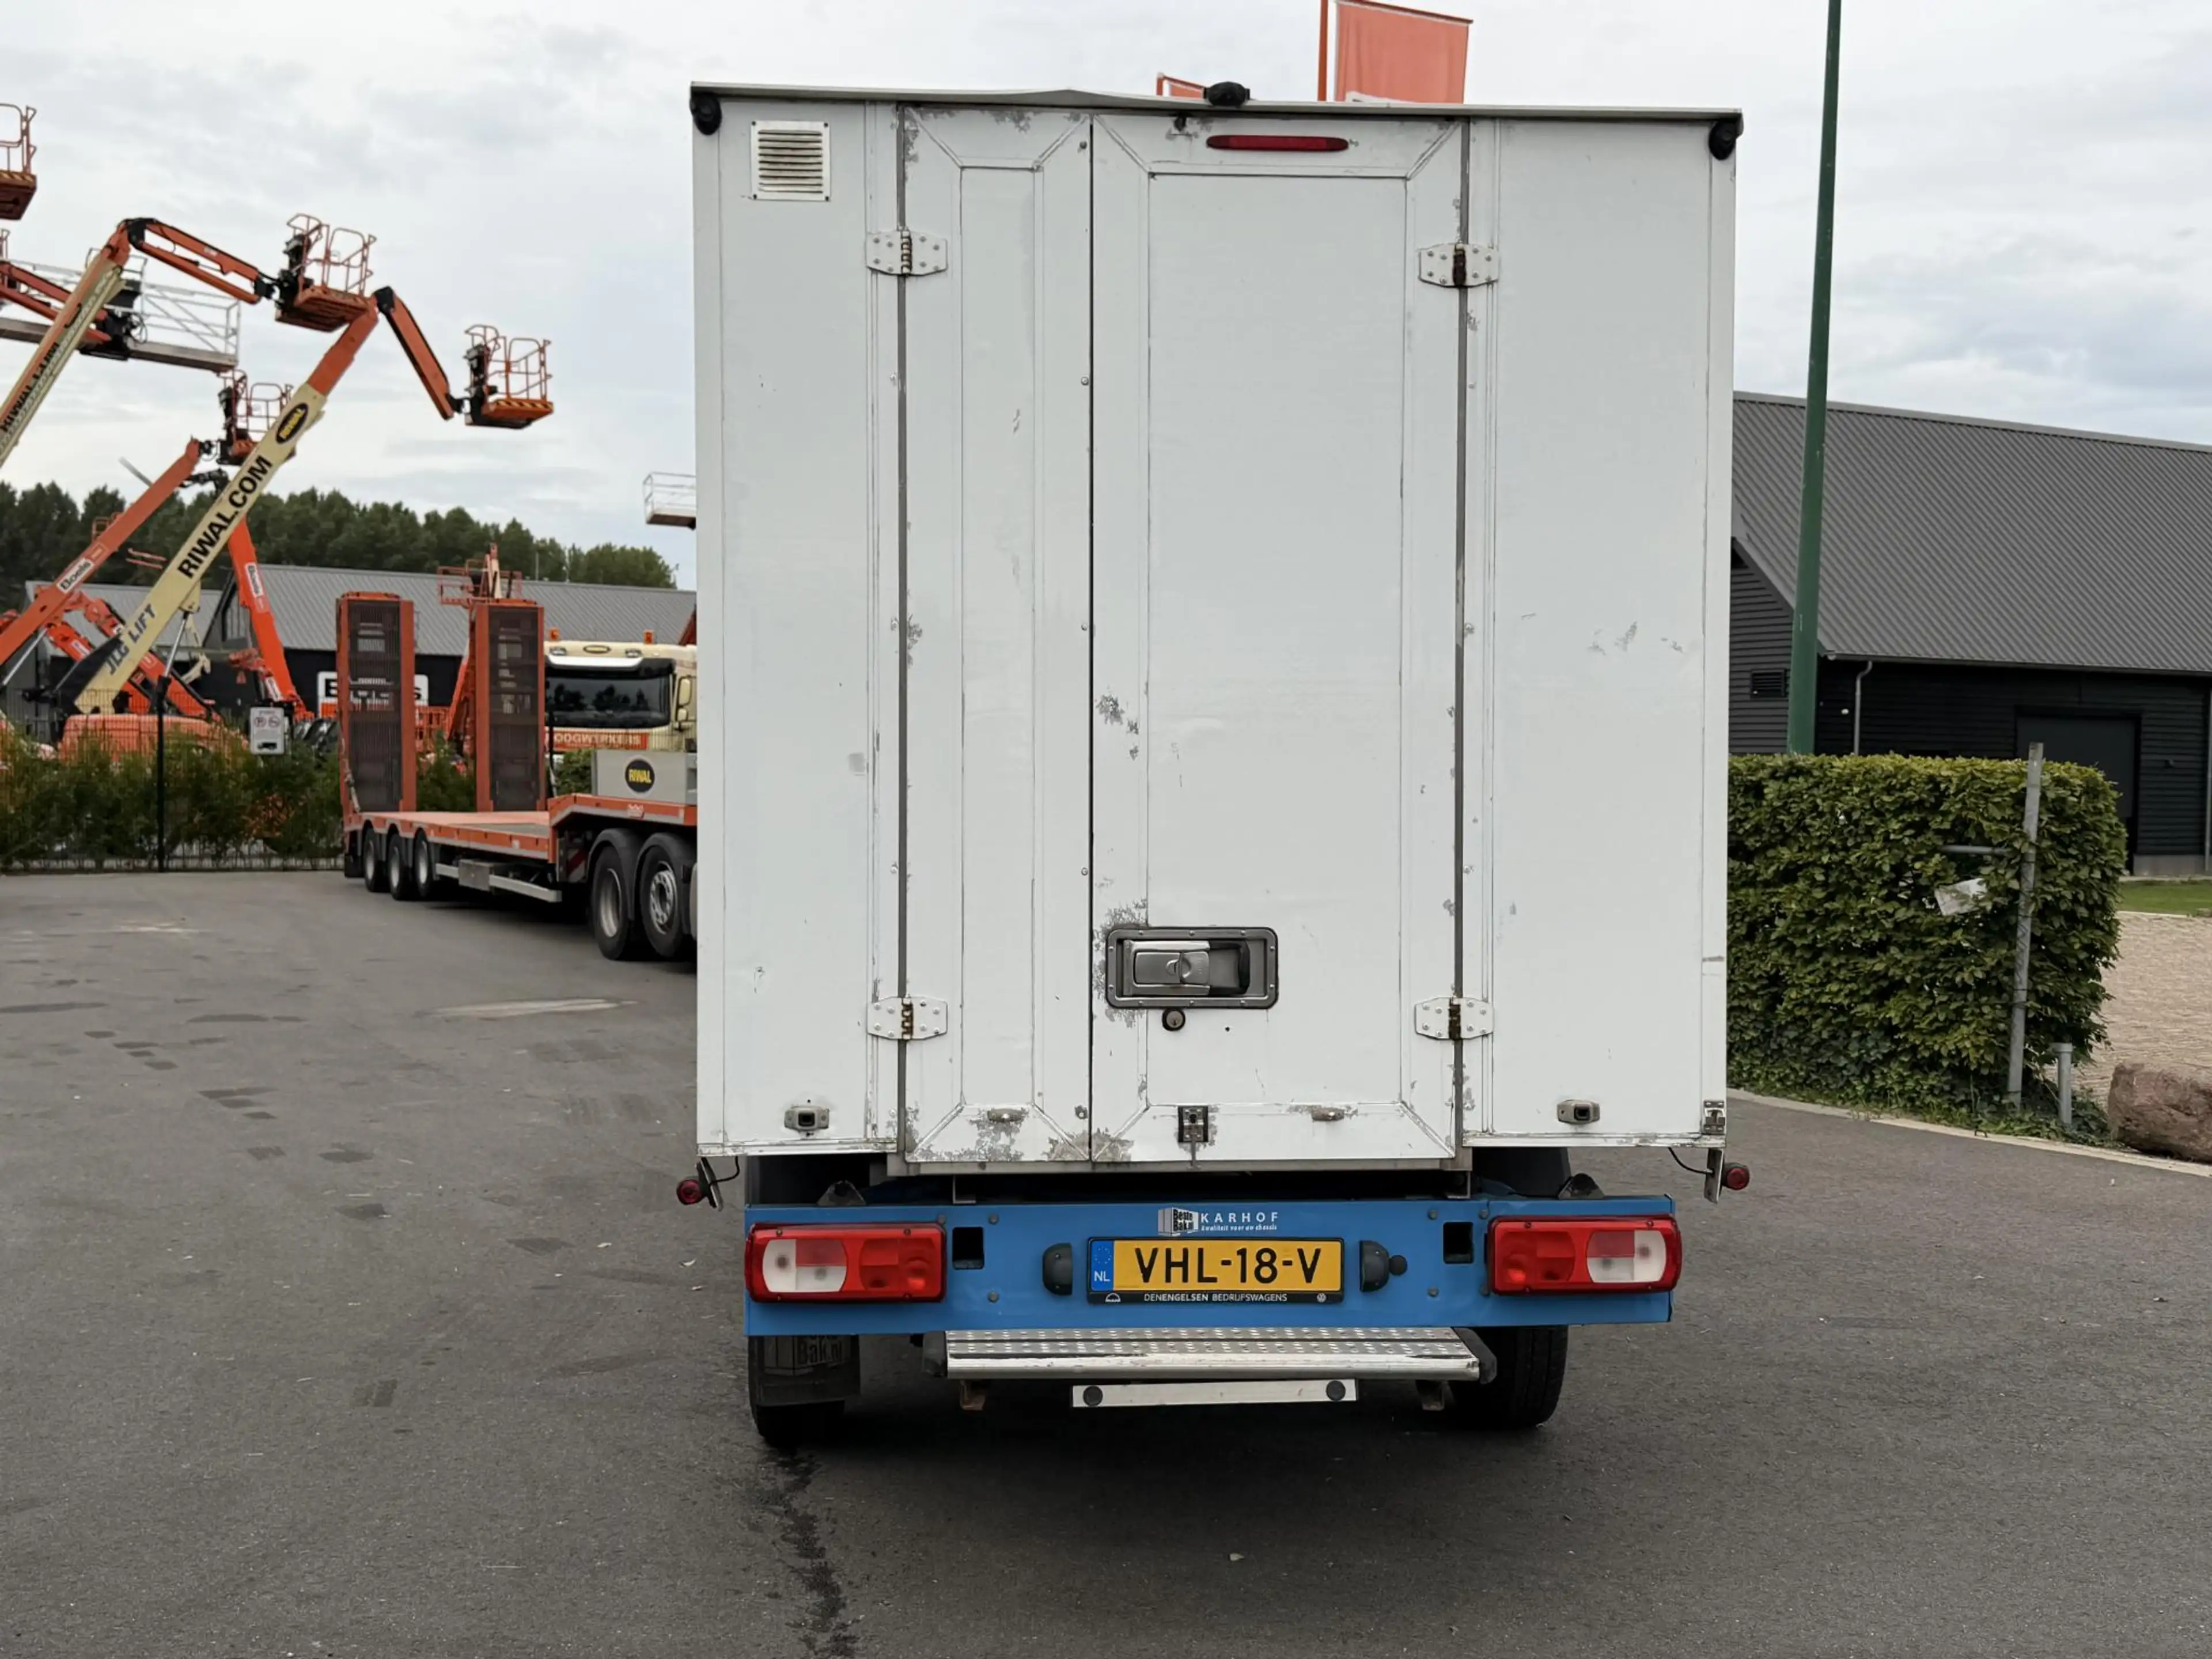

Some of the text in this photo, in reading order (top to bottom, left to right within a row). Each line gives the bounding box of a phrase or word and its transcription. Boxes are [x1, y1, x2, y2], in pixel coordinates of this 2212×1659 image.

[177, 454, 273, 579] RIWAL.COM
[107, 603, 157, 675] JLG LIFT
[628, 768, 652, 784] RIWAL
[1200, 1211, 1278, 1223] KARHOF
[1134, 1247, 1321, 1284] VHL-18-V
[1094, 1271, 1111, 1282] NL
[1143, 1294, 1287, 1302] DENENGELSEN BEDRIJFSWAGENS
